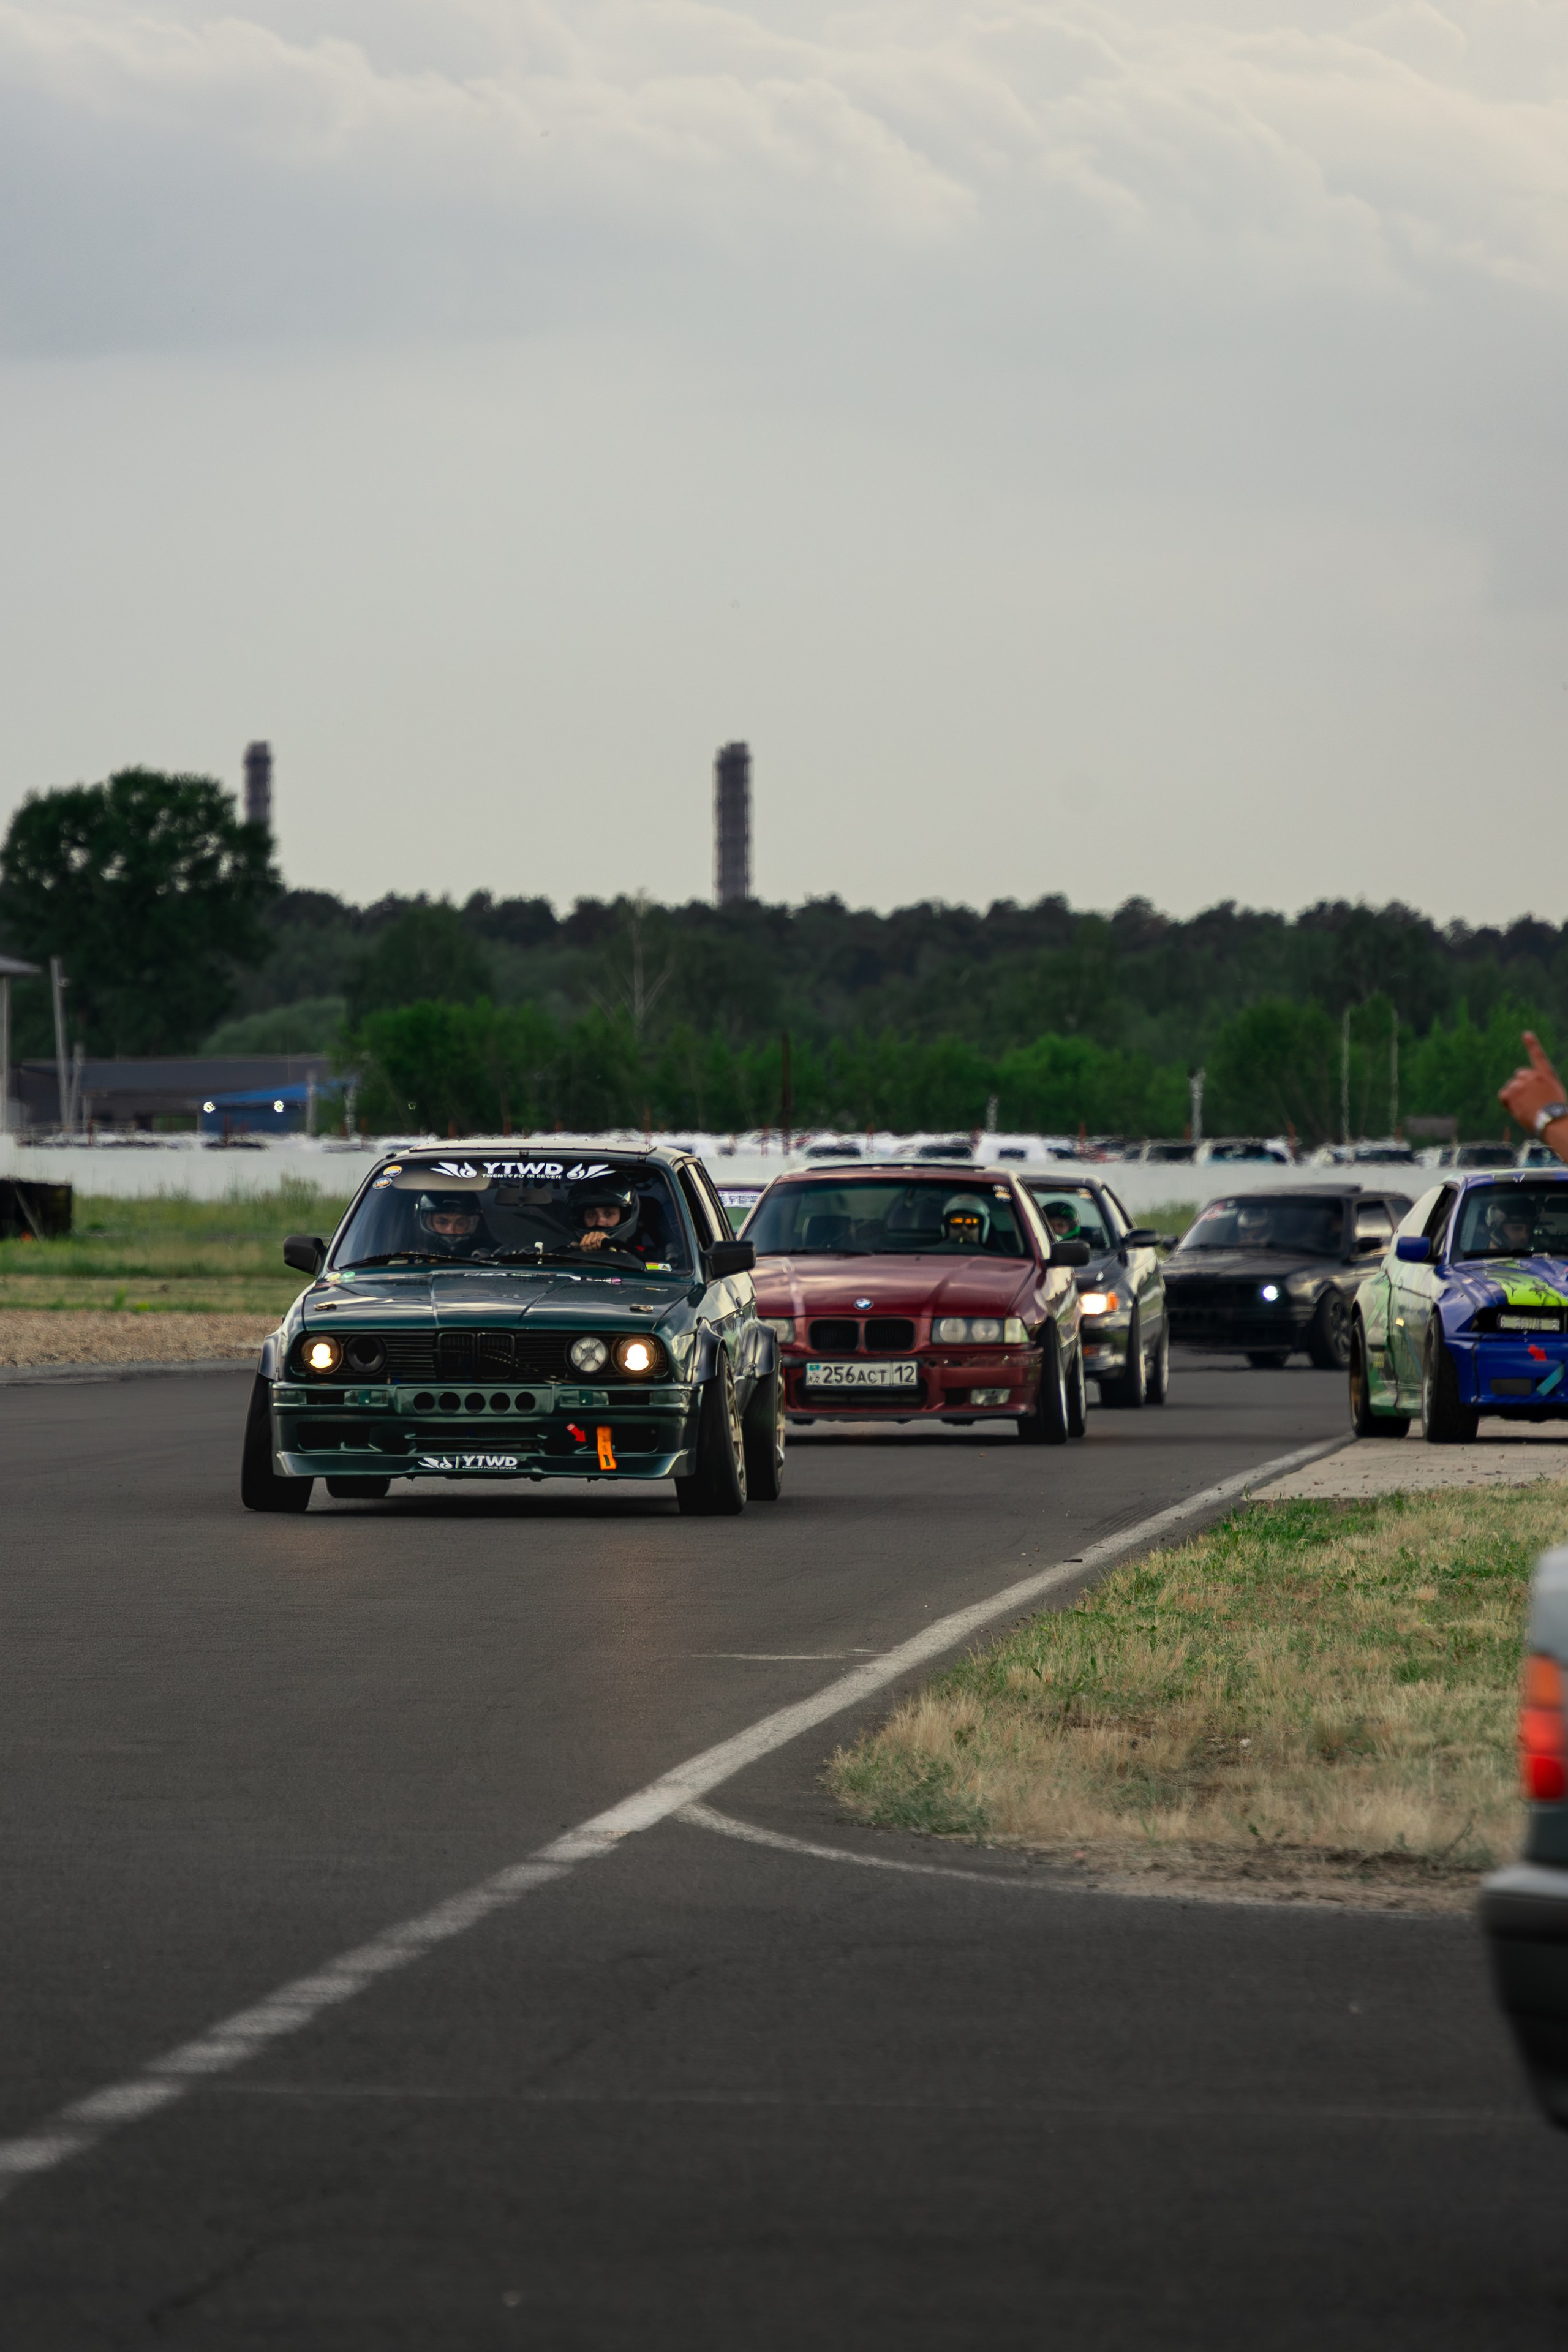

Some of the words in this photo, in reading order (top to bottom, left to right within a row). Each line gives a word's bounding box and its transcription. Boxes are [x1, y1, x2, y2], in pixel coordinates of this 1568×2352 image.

[482, 1162, 564, 1175] YTWD
[894, 1365, 915, 1384] 12
[462, 1455, 519, 1466] YTWD
